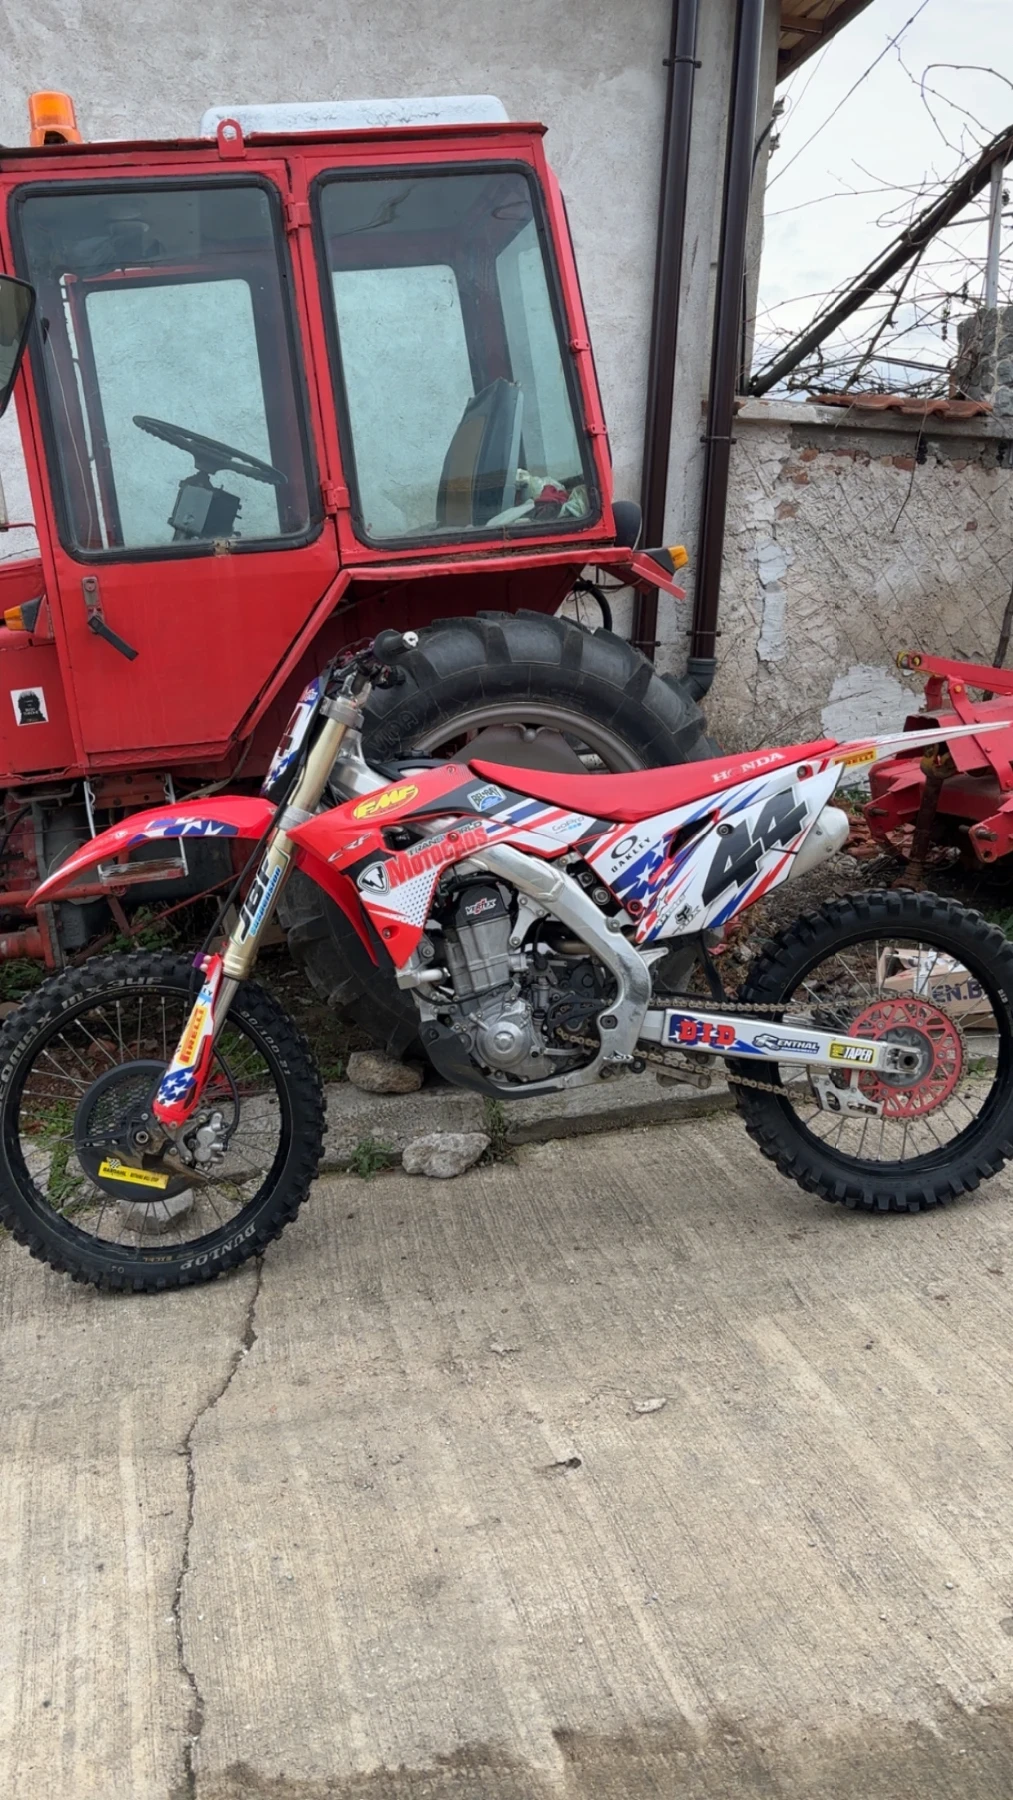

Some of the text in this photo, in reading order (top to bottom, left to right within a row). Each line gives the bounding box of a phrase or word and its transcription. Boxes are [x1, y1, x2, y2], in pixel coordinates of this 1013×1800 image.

[711, 752, 786, 783] HONDA
[356, 785, 415, 818] FMF
[328, 832, 372, 862] CRF
[408, 821, 483, 855] TRANSORLD
[701, 786, 809, 907] 44
[611, 837, 651, 873] OAKLEY
[843, 1046, 873, 1062] TAPER
[180, 1222, 256, 1270] DUNLOP
